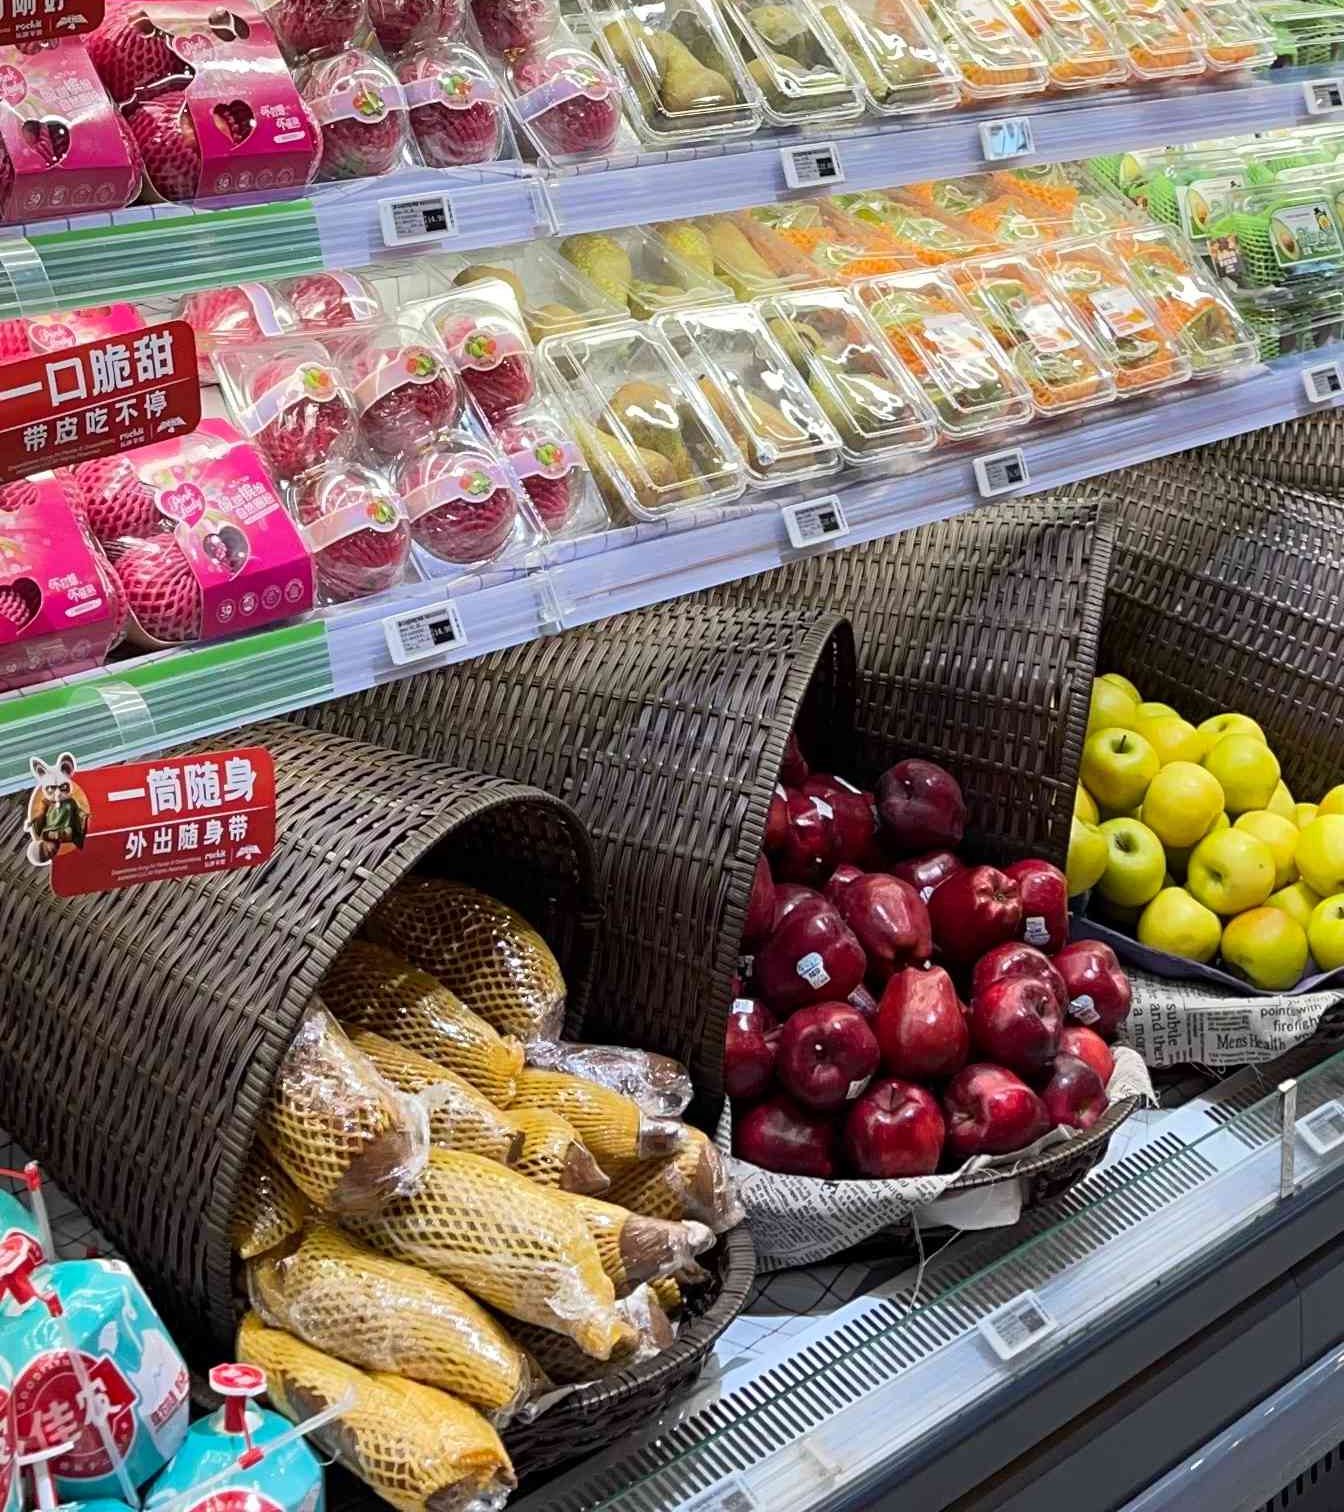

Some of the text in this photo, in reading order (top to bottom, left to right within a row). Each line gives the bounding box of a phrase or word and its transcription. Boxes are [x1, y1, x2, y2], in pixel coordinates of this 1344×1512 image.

[0, 330, 174, 407] 一口脆甜
[23, 390, 168, 452] 带皮吃不停
[107, 756, 256, 816] 一筒随身
[124, 814, 249, 861] 外出随身带
[1150, 1003, 1165, 1032] and
[1167, 1003, 1182, 1046] subtle
